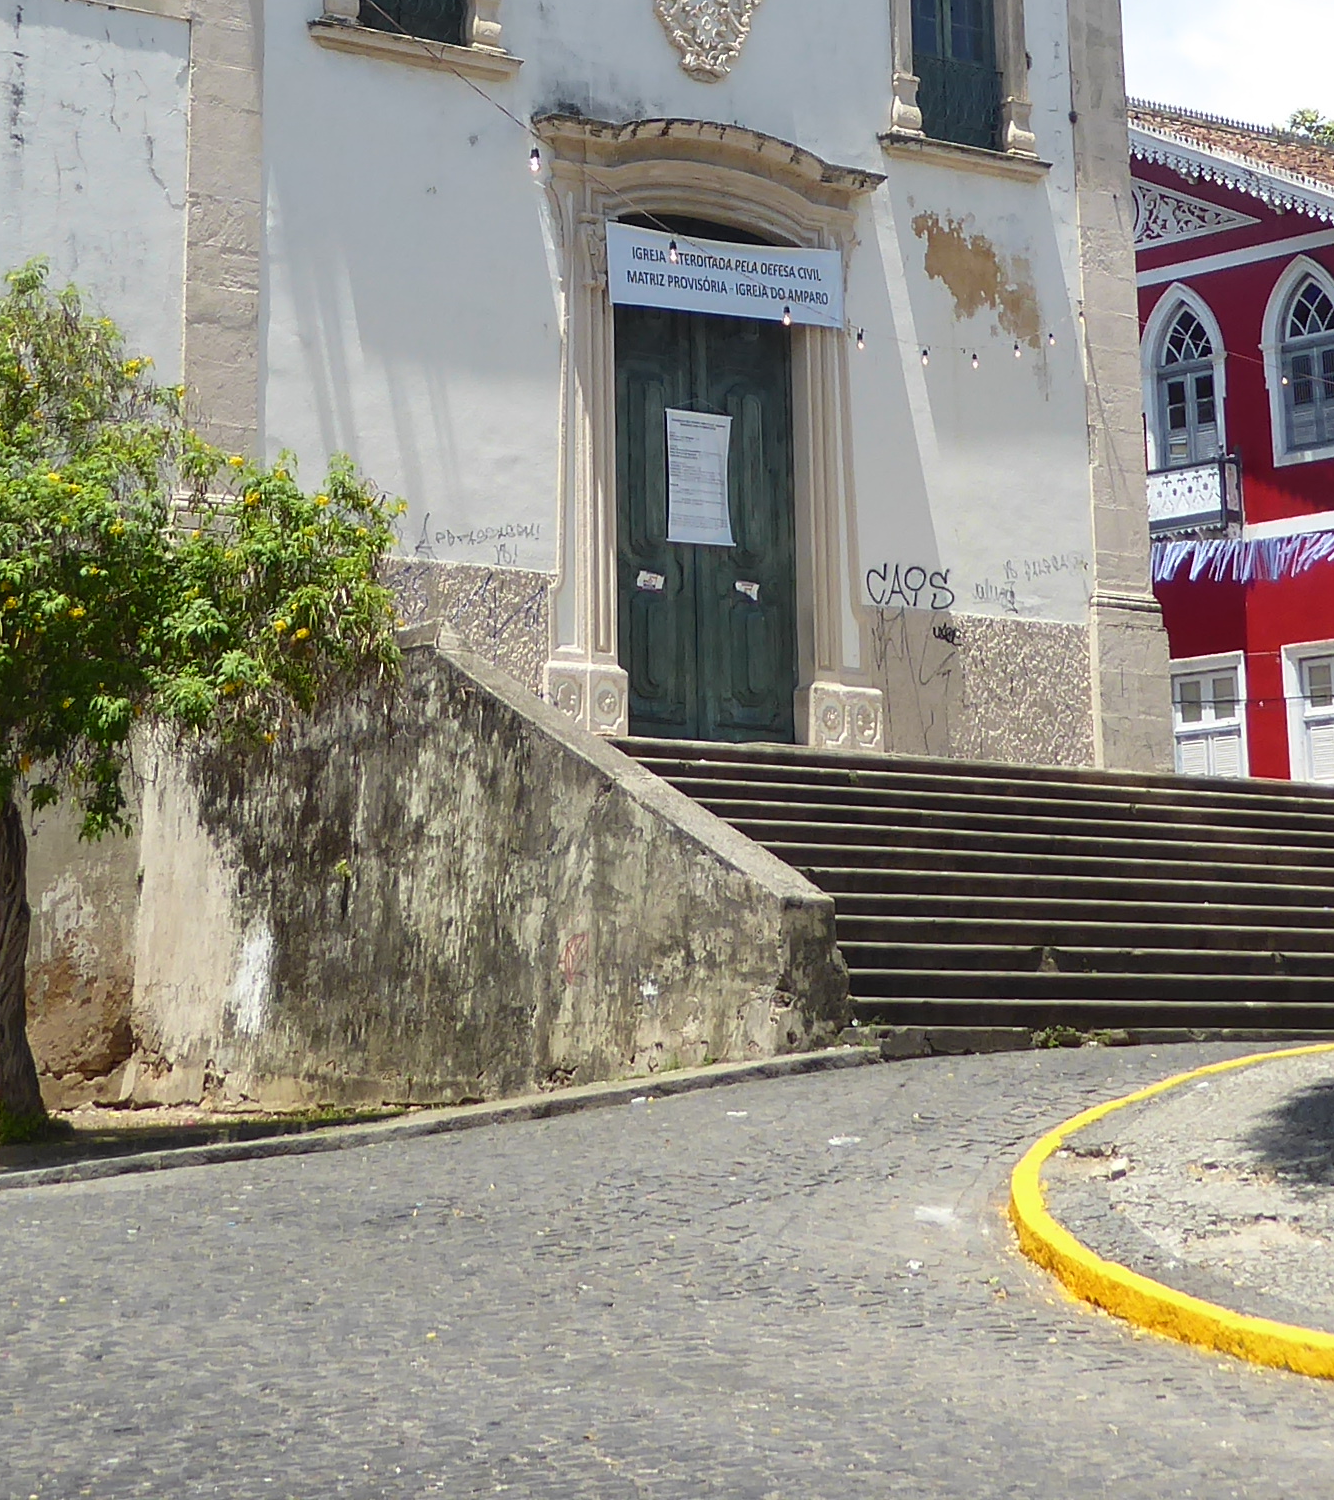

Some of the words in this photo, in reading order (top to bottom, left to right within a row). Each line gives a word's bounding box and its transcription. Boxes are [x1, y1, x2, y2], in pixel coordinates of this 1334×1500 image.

[632, 246, 666, 263] IGREJA
[669, 251, 733, 271] TERDITADA
[735, 259, 758, 274] PELA
[760, 263, 796, 278] DEFESA
[798, 267, 822, 281] CIVIL
[627, 270, 665, 286] MATRIZ
[667, 275, 728, 295] PROVISÓRIA
[735, 282, 769, 299] IGREJA
[771, 287, 786, 300] DO
[787, 289, 829, 305] AMPARO
